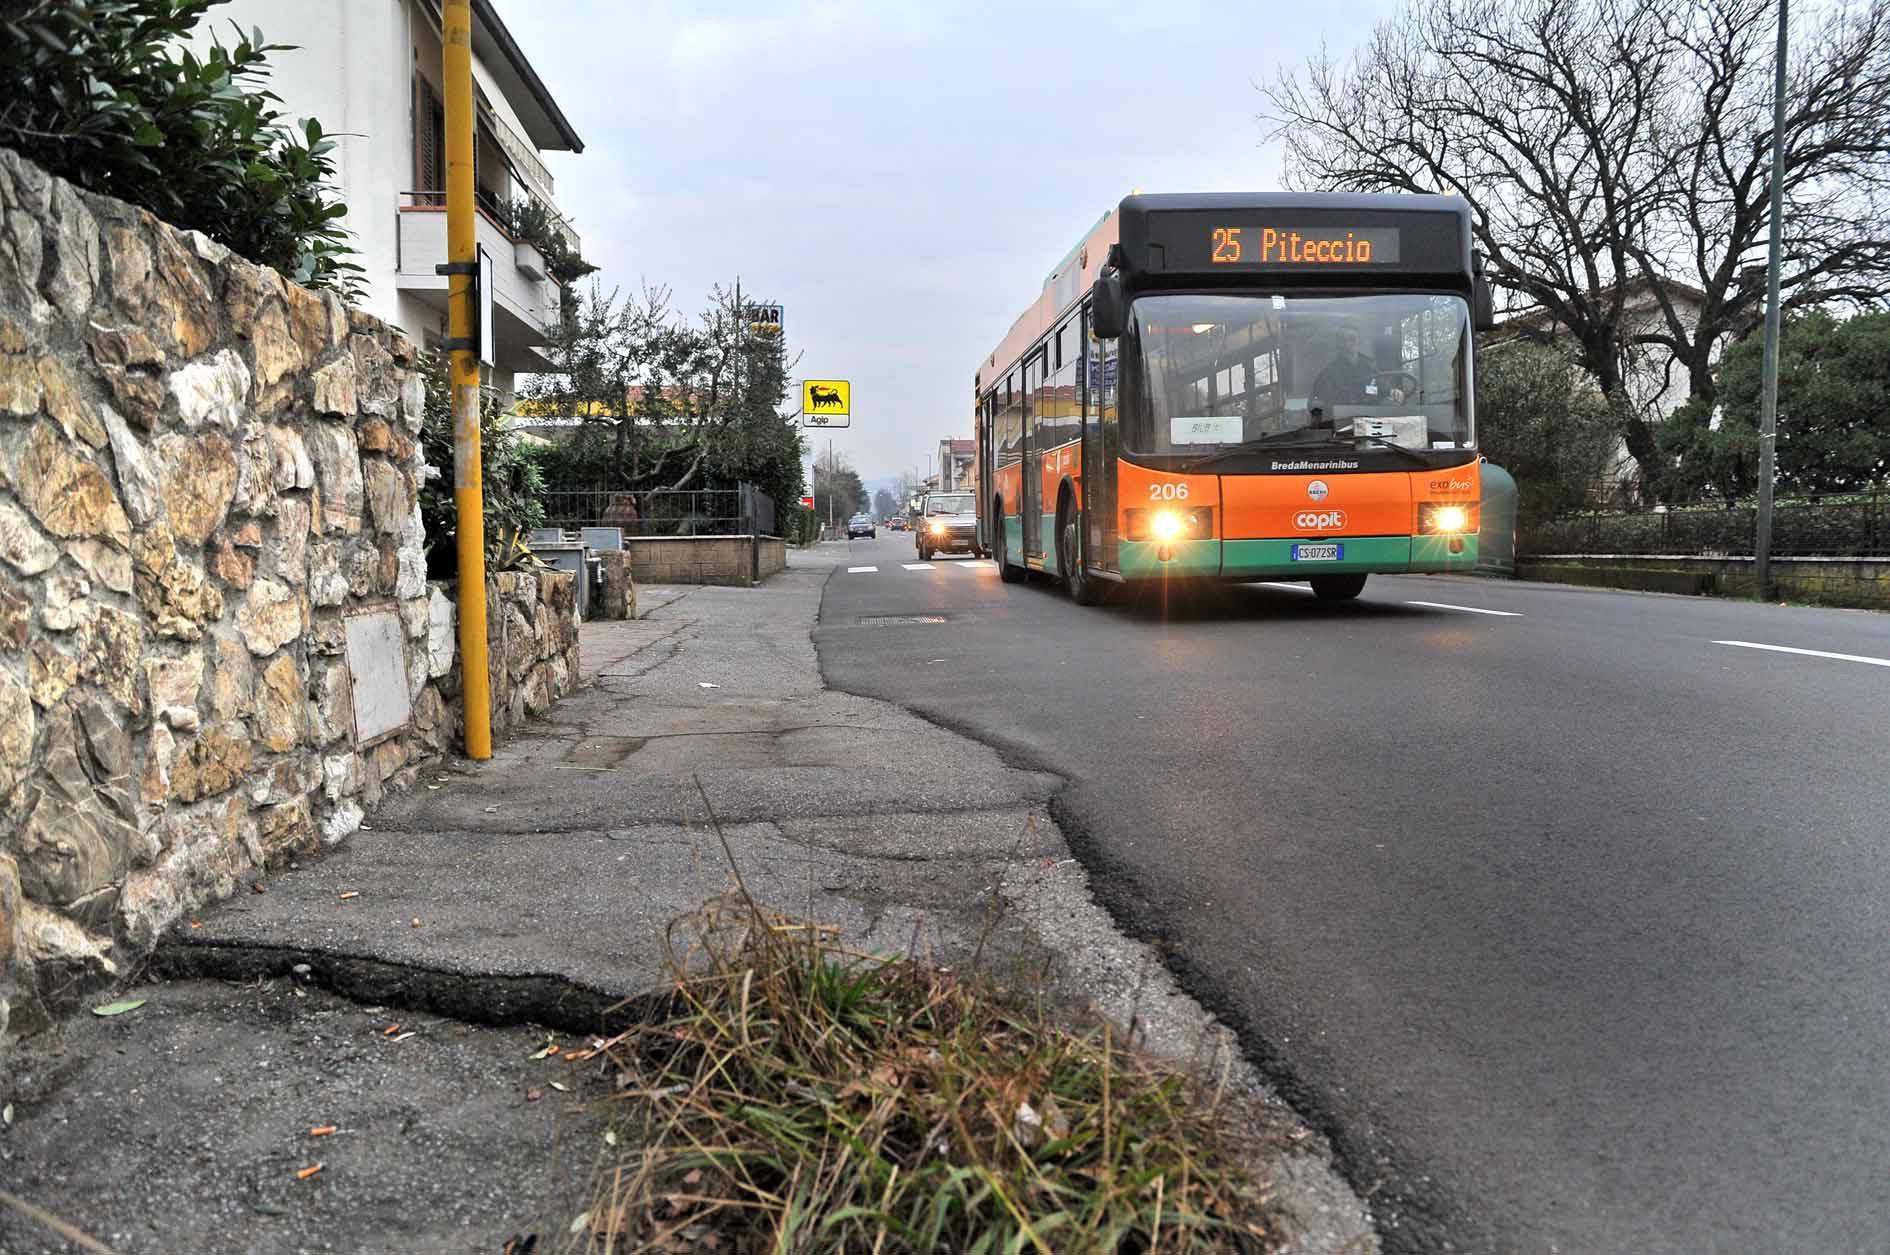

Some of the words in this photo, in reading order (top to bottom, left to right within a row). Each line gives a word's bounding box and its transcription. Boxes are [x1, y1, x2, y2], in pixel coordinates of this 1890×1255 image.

[1212, 228, 1241, 263] 25
[1262, 228, 1371, 263] Piteccio
[811, 415, 829, 425] Agip
[1271, 461, 1359, 471] BredaMenarinibus
[1150, 483, 1189, 500] 206
[1297, 511, 1342, 531] copit
